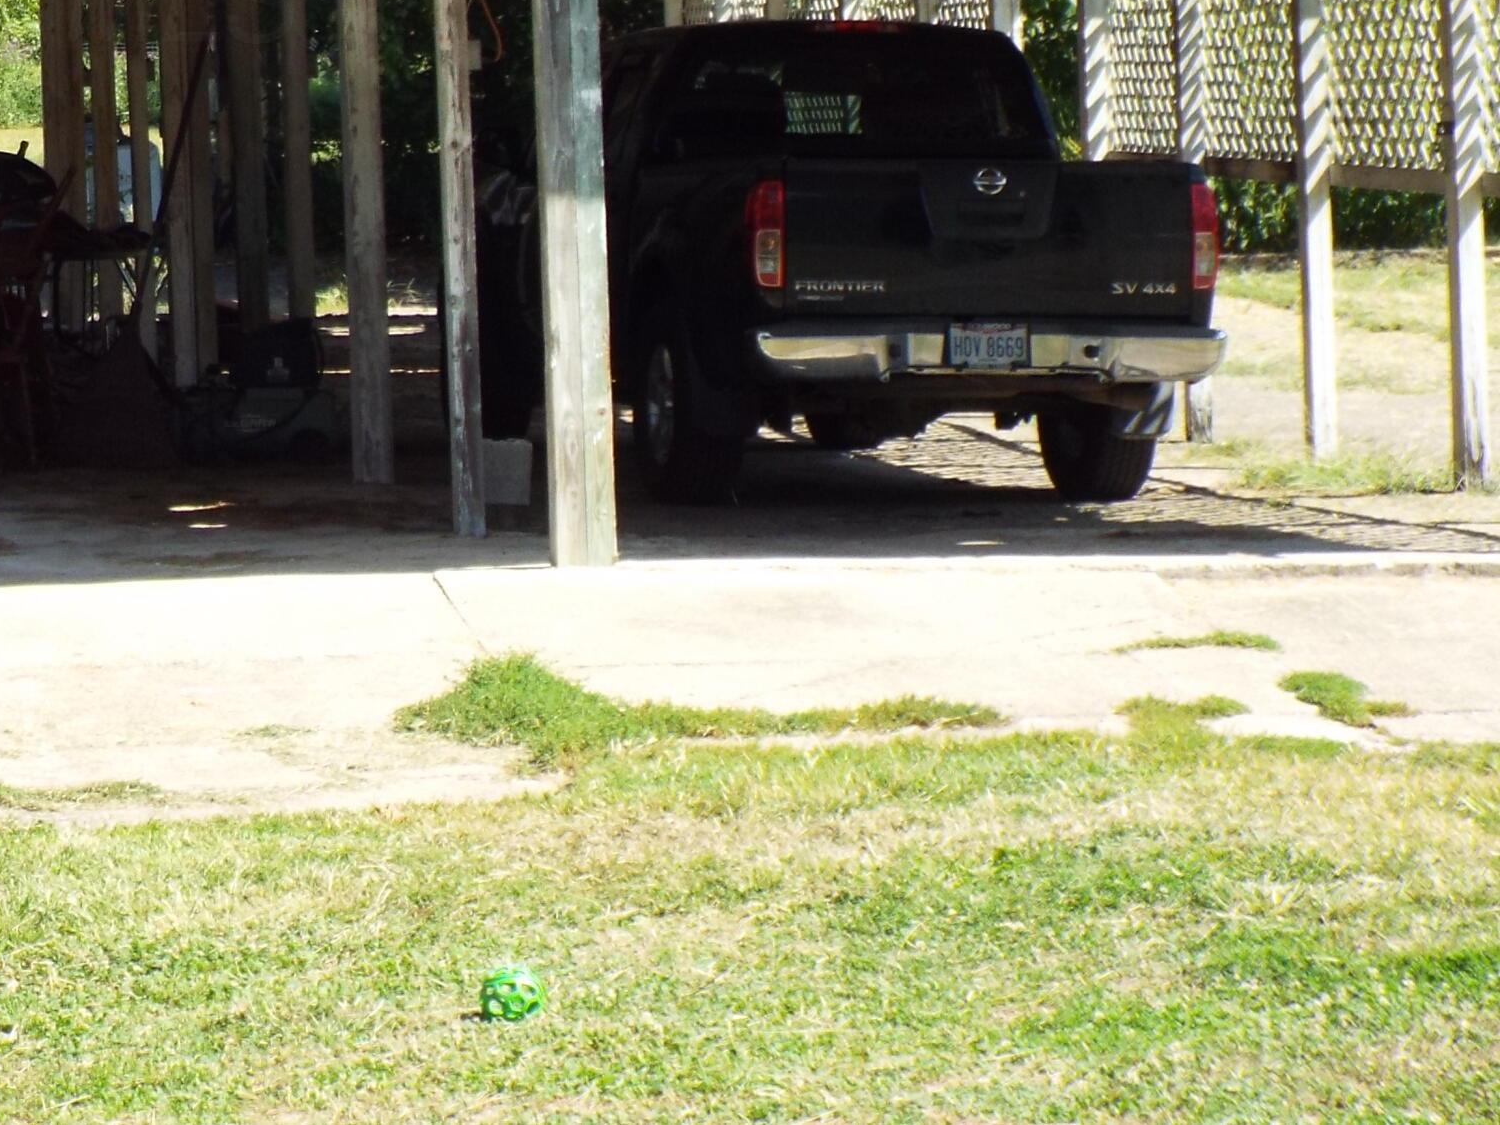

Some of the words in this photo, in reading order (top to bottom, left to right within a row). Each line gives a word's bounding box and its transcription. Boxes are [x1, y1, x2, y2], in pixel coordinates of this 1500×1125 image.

[794, 279, 885, 292] FRONTIER
[1110, 282, 1138, 295] SV
[1143, 282, 1177, 295] 4x4
